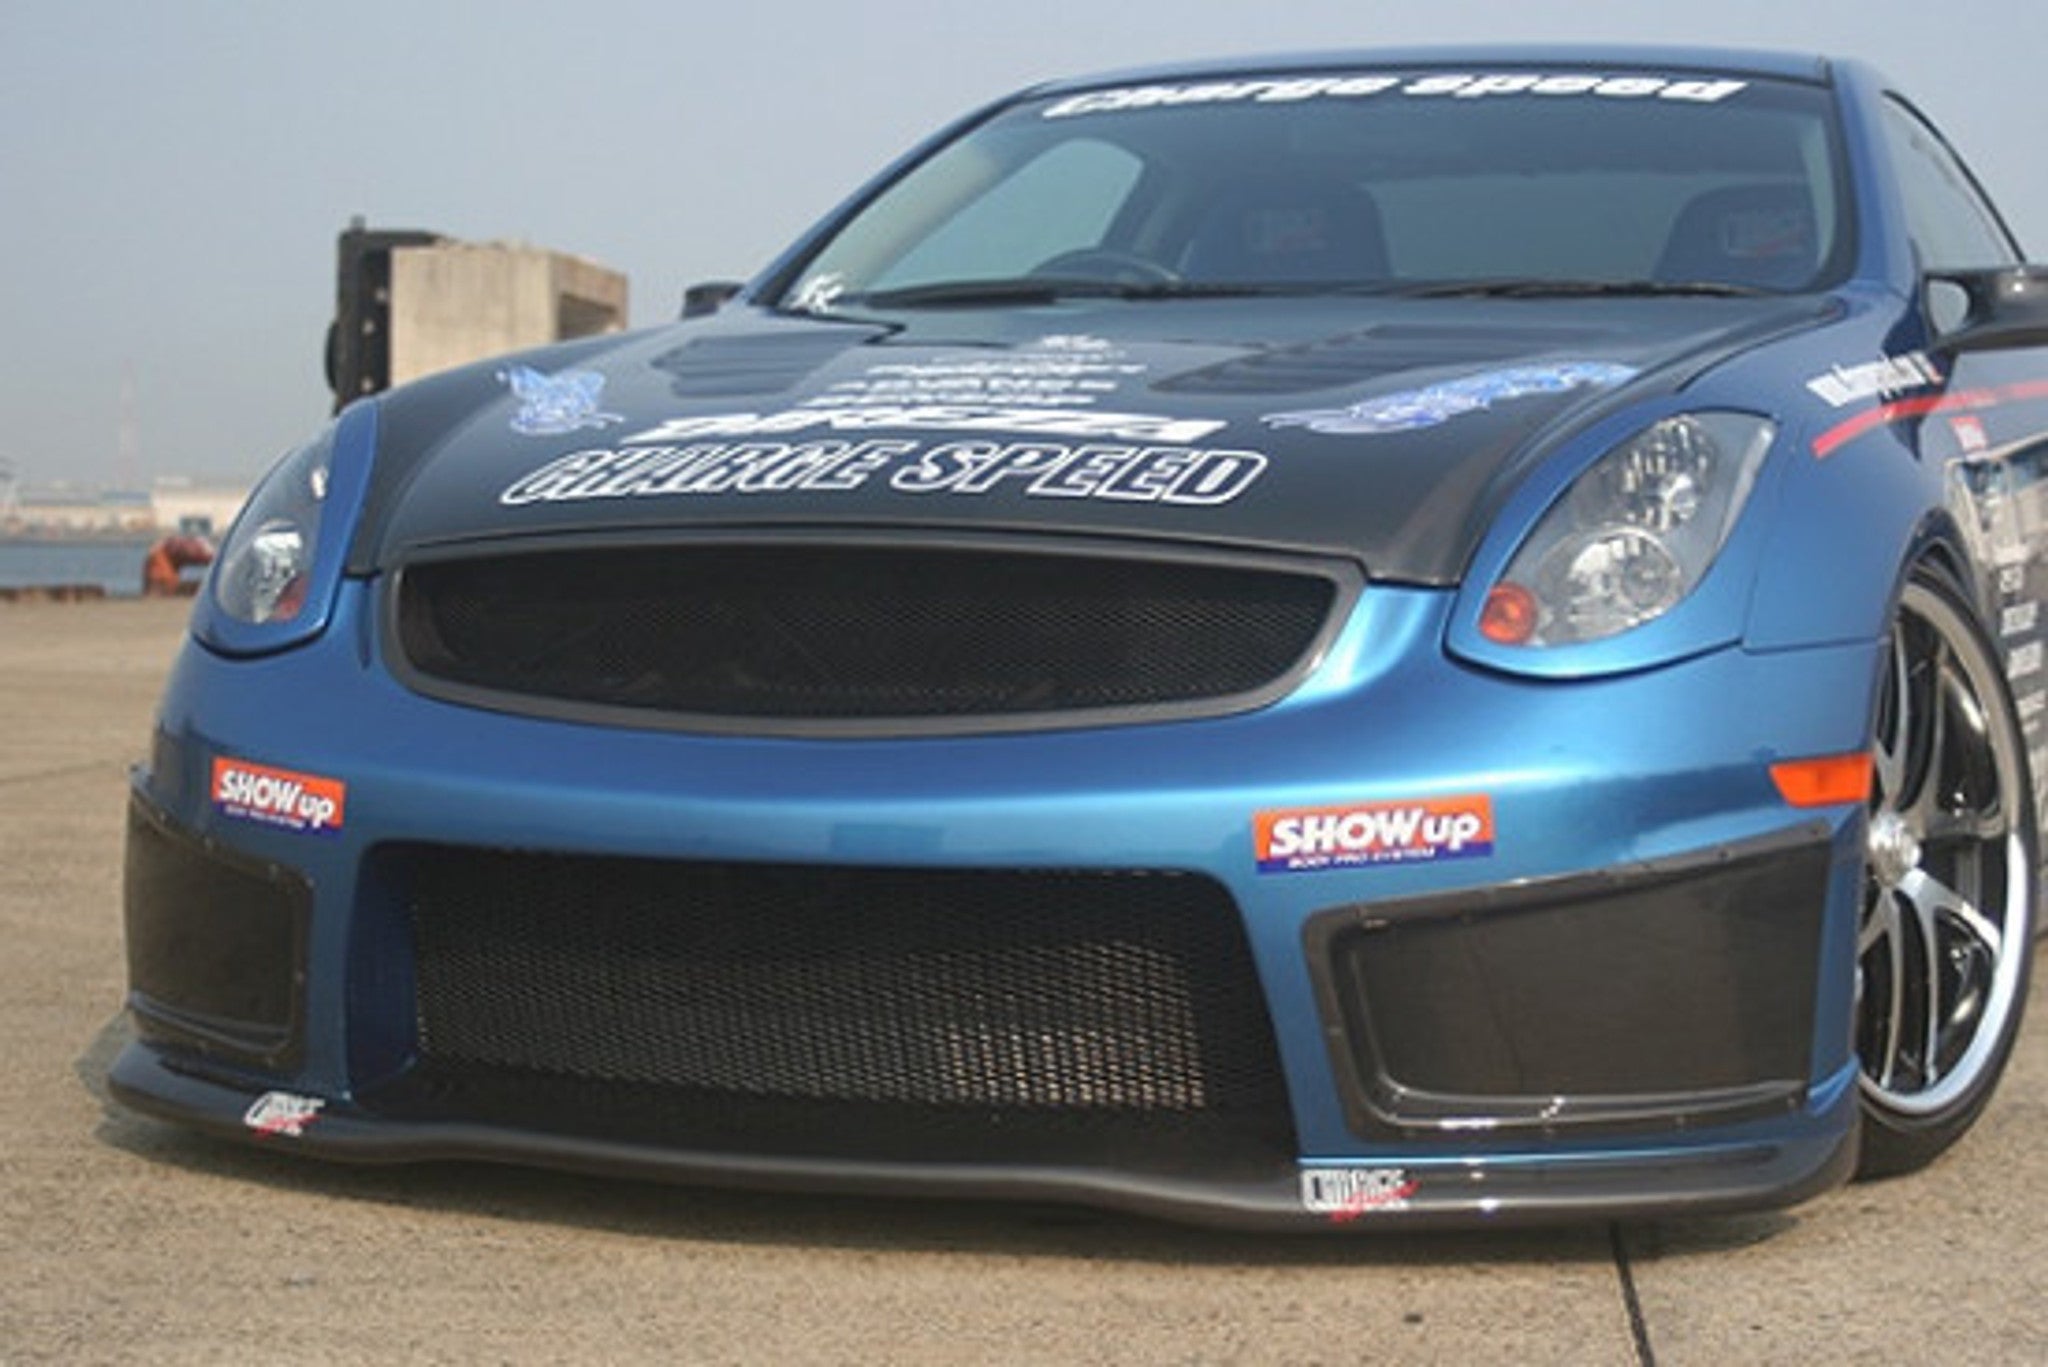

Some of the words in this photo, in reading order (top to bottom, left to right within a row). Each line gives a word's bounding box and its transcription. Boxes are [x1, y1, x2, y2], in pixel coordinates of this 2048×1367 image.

[1403, 74, 1748, 101] speed
[500, 439, 917, 504] CHARGE
[891, 441, 1268, 504] SPEED
